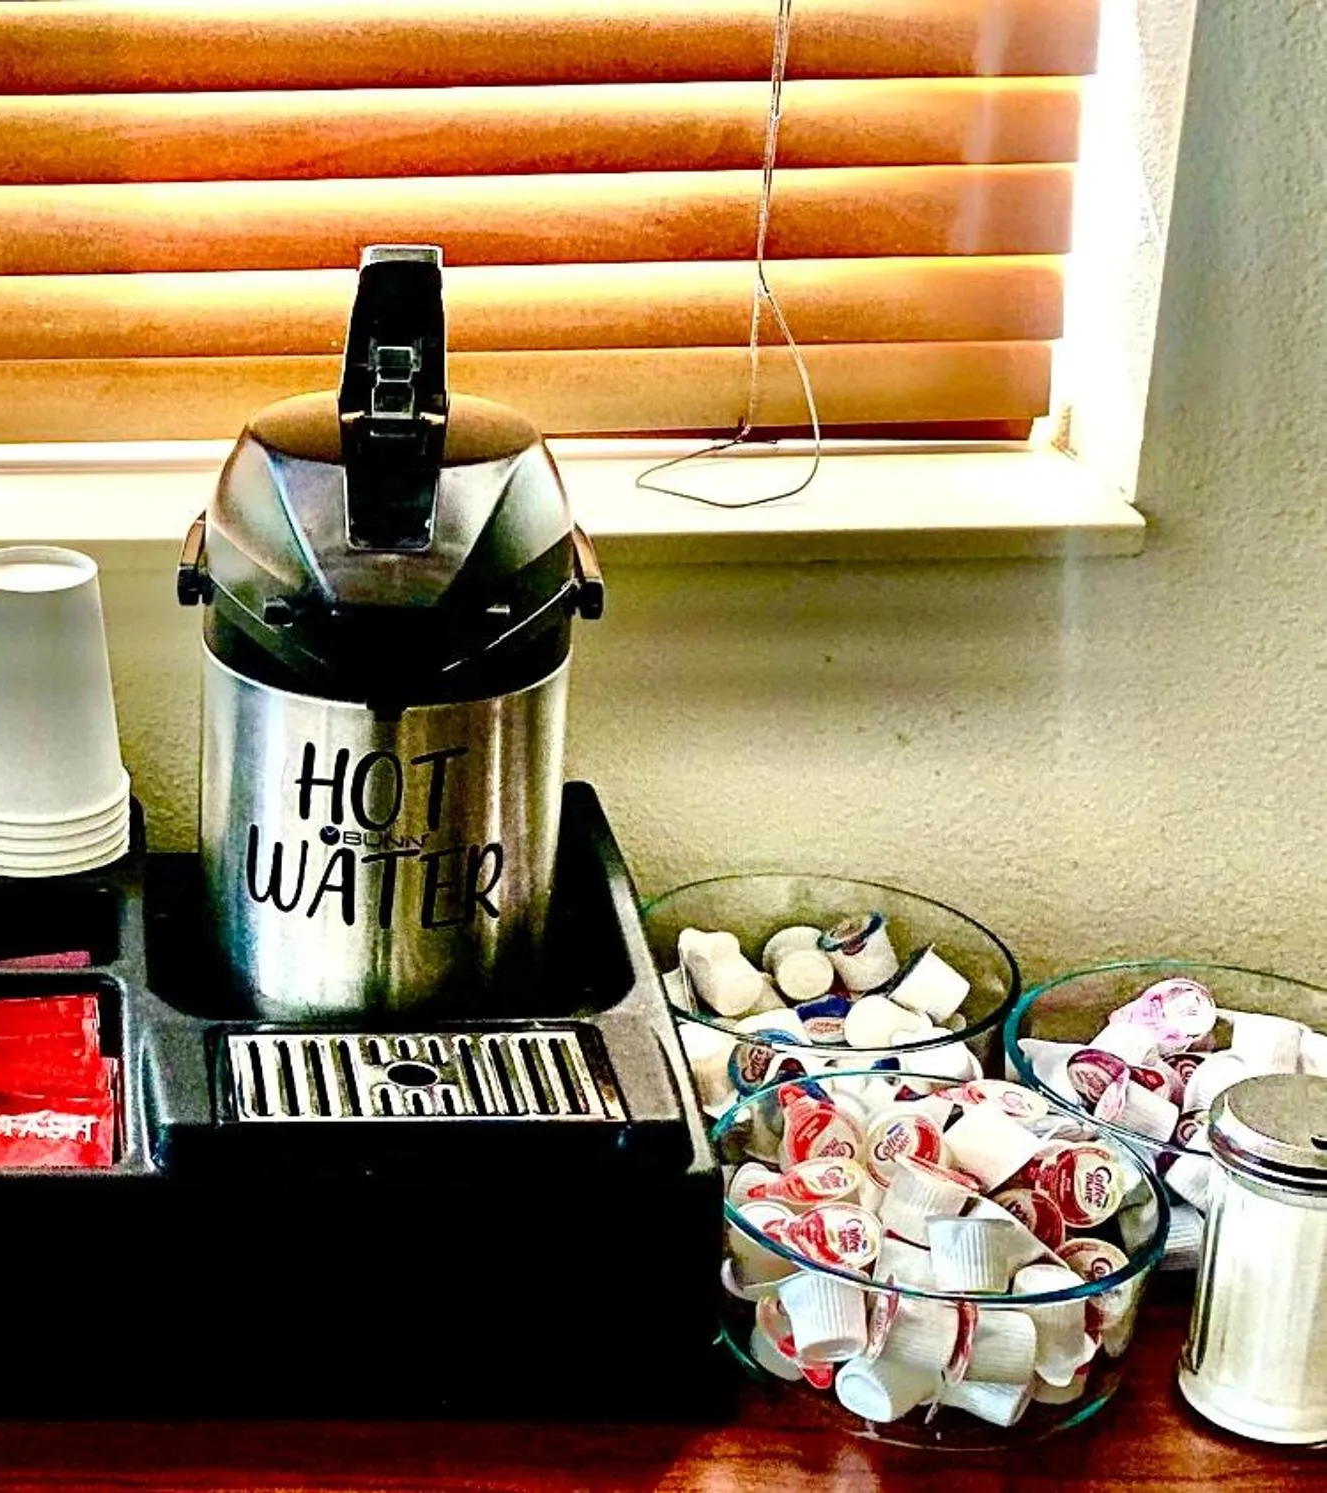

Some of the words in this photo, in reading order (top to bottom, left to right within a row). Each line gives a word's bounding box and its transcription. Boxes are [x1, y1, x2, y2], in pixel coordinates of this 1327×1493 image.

[295, 741, 469, 832] HOT
[342, 830, 431, 849] BUNN
[246, 823, 504, 930] WATER
[1093, 1166, 1112, 1208] Coffee
